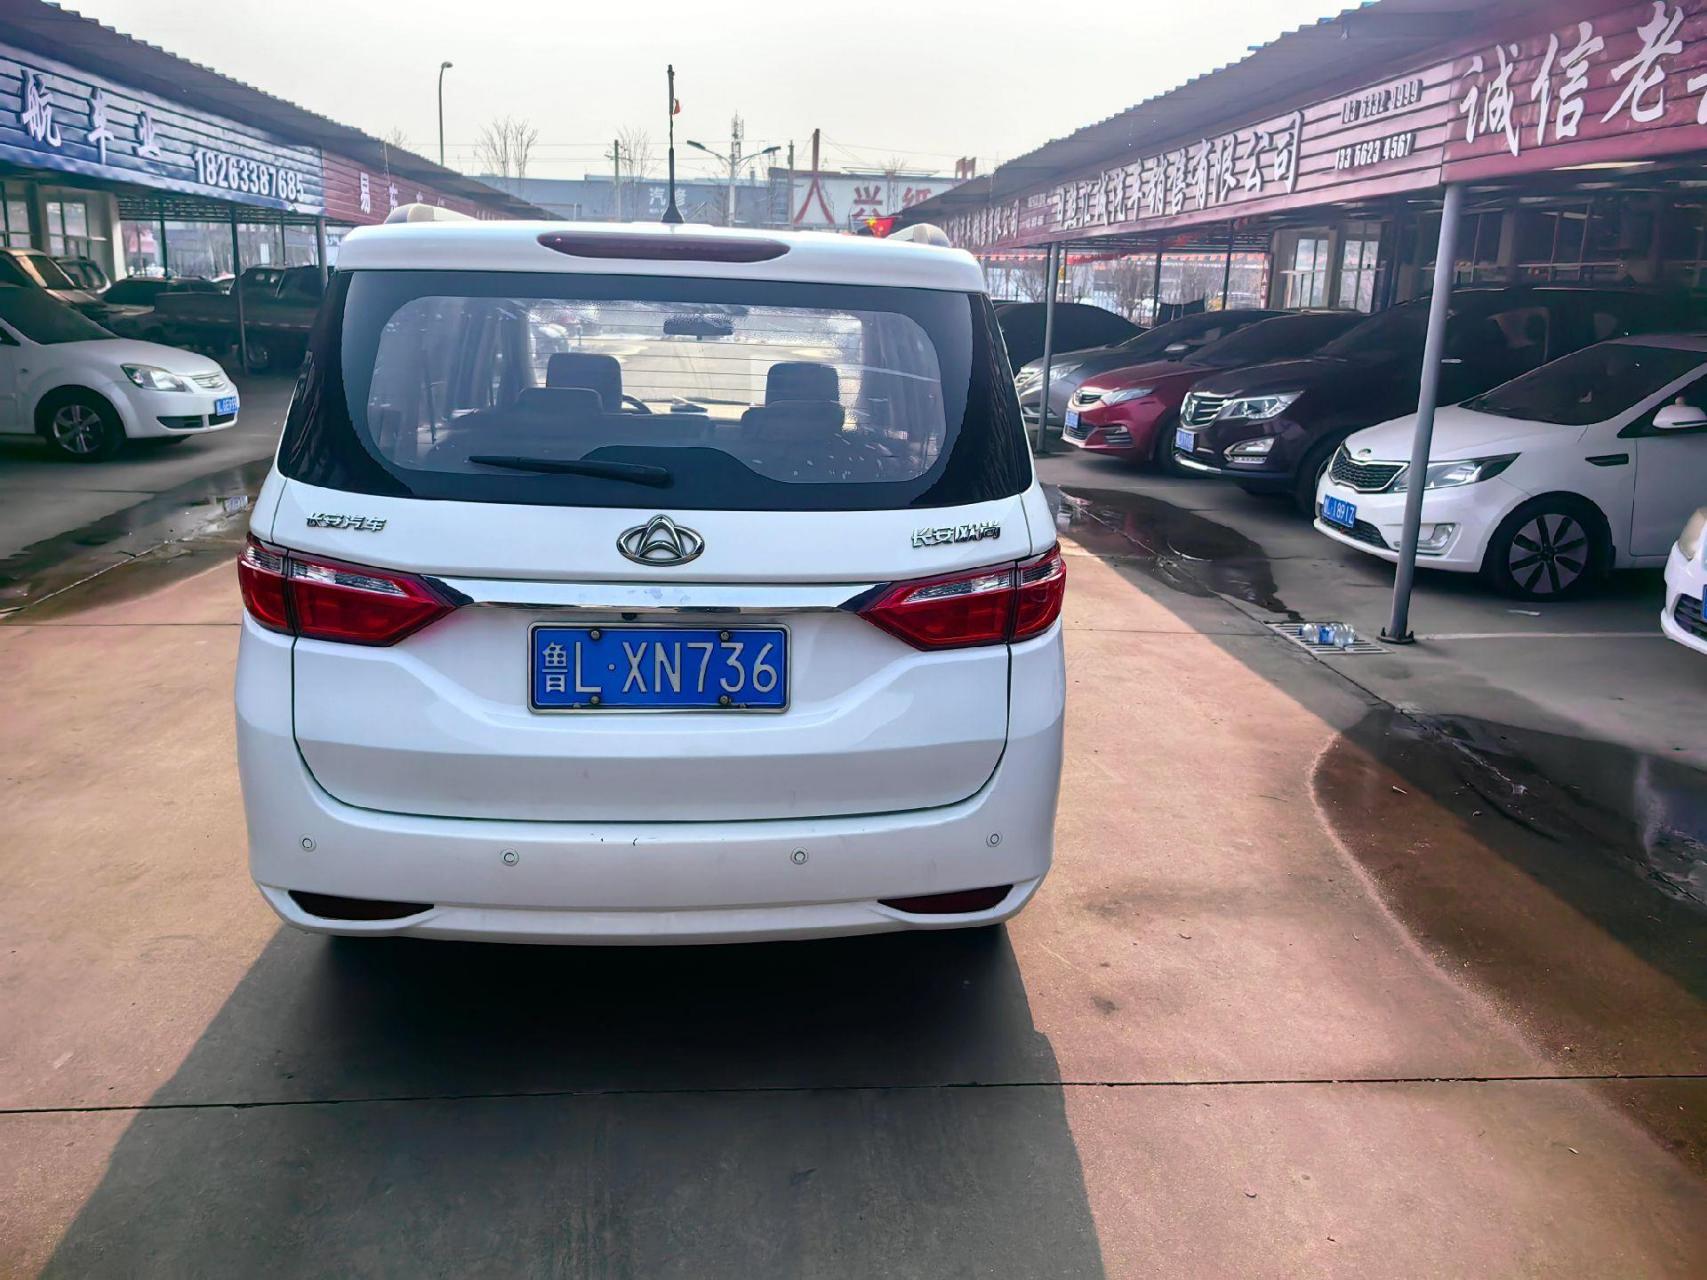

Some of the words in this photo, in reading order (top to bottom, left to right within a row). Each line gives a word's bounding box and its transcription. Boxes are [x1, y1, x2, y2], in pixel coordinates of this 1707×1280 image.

[1460, 1, 1707, 156] 诚信老
[21, 70, 161, 165] 航车业
[1383, 132, 1412, 160] 4567
[194, 151, 304, 202] 18263387685
[542, 641, 778, 693] 鲁L·XN736
